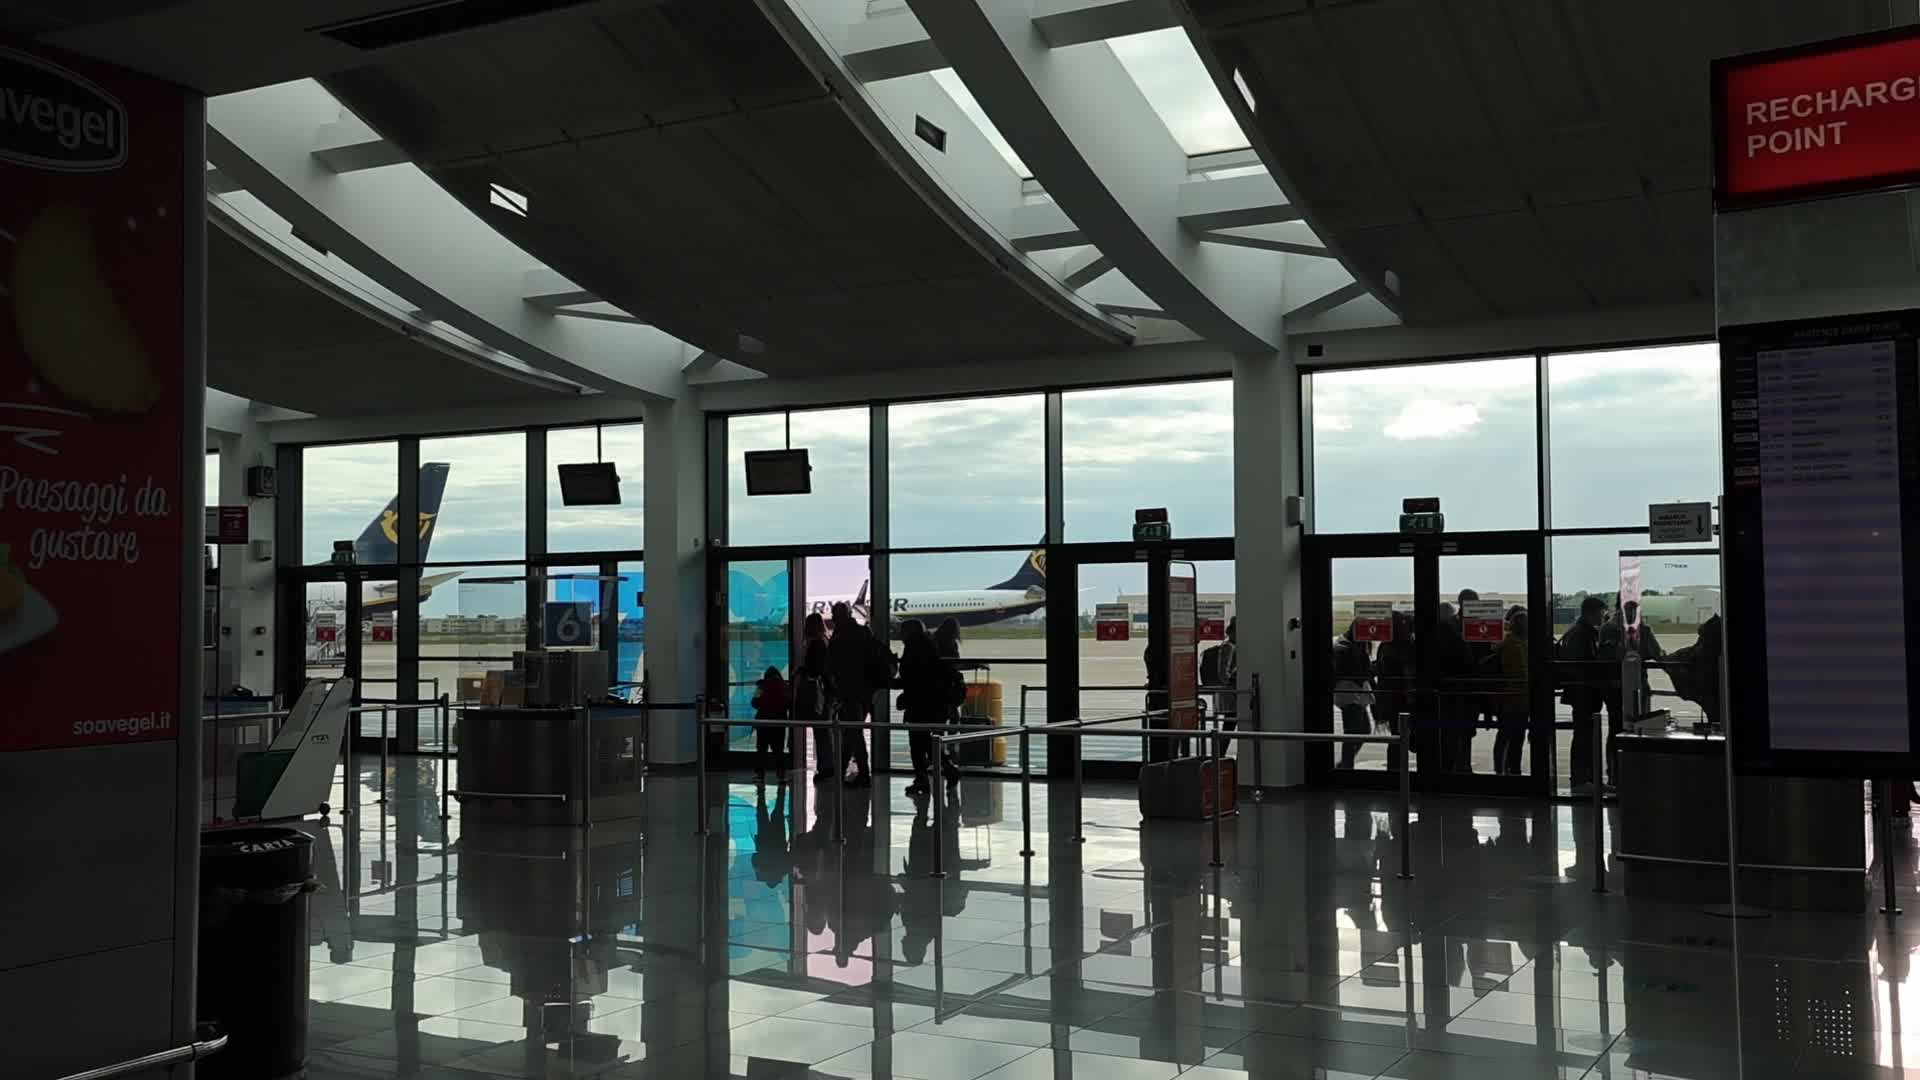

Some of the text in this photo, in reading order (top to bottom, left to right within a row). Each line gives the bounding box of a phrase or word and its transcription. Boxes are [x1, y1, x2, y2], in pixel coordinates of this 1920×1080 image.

[1745, 74, 1920, 126] RECHARG
[1746, 121, 1848, 158] POINT
[0, 465, 171, 523] Paesaggi da
[28, 525, 140, 570] gustare
[556, 607, 581, 642] 6
[71, 711, 173, 736] soavegel.it
